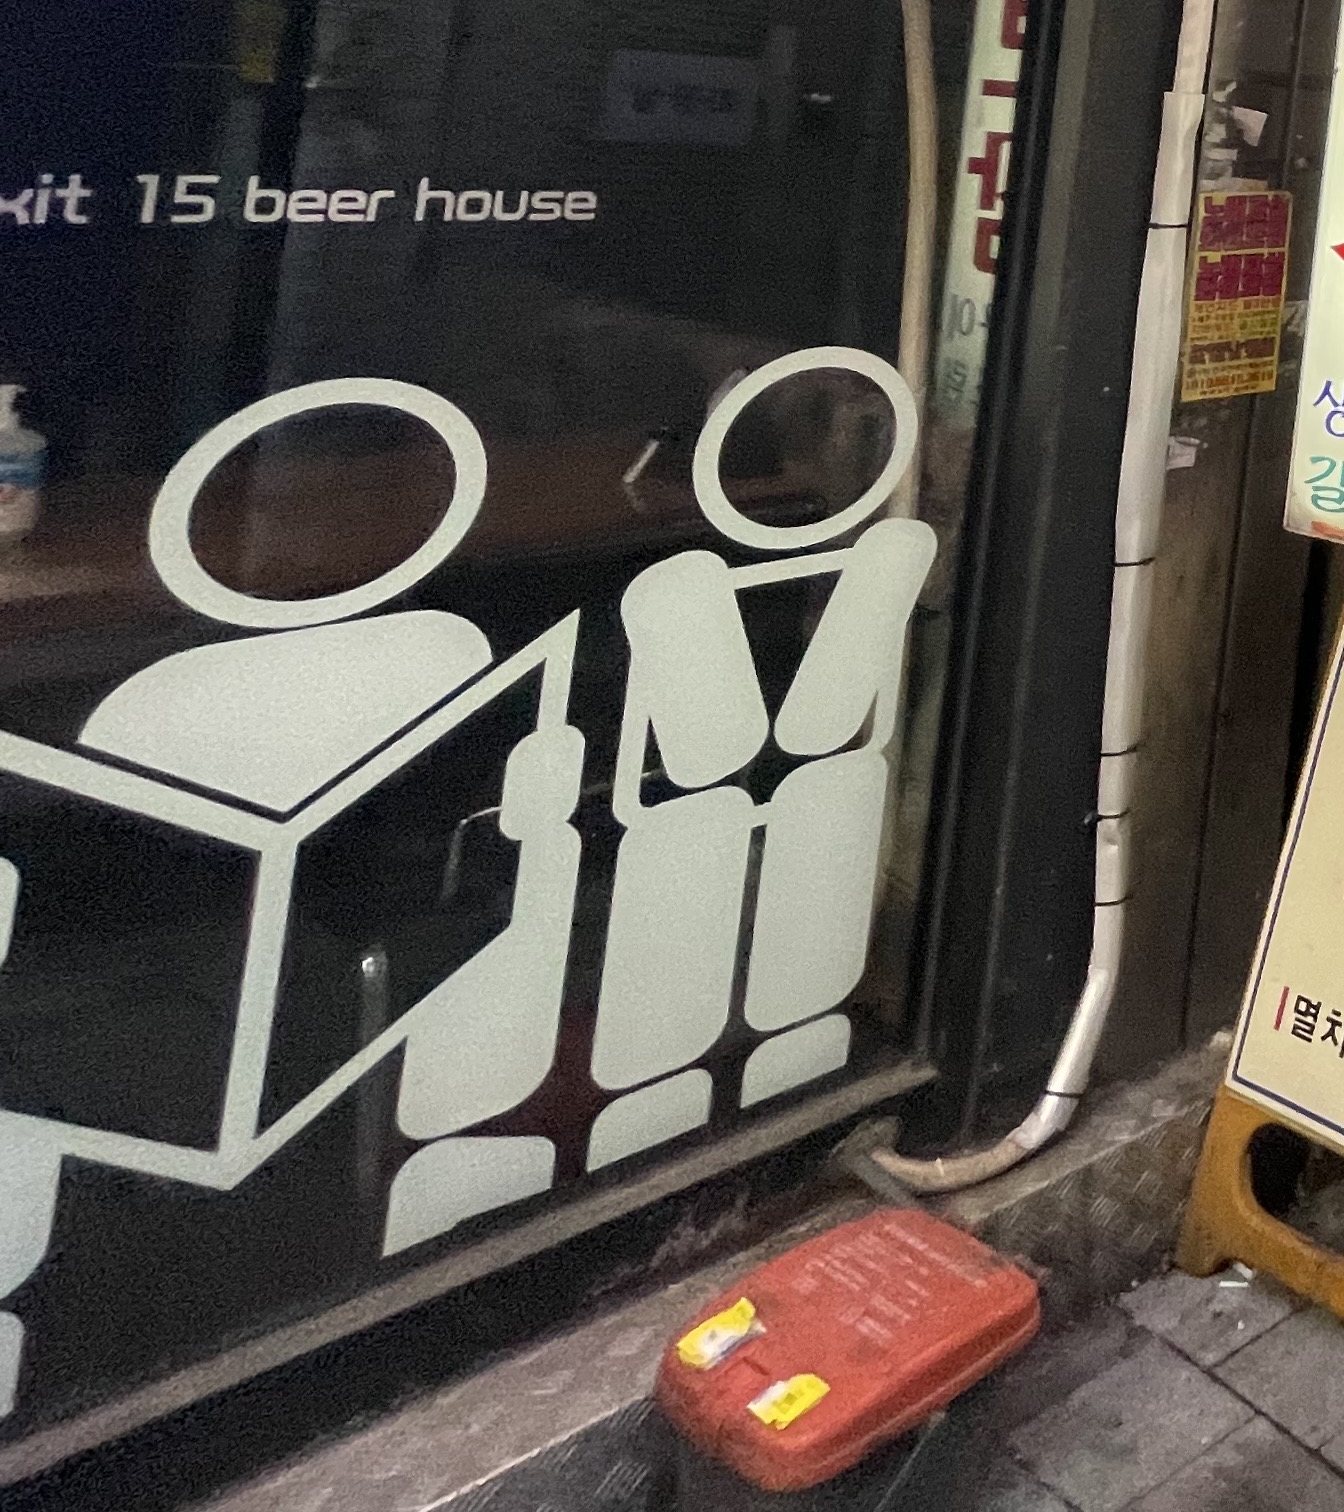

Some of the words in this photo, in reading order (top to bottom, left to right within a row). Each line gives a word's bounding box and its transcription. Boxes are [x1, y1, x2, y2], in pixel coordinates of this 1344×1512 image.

[135, 173, 221, 224] 15
[242, 174, 396, 224] beer
[414, 175, 598, 223] house
